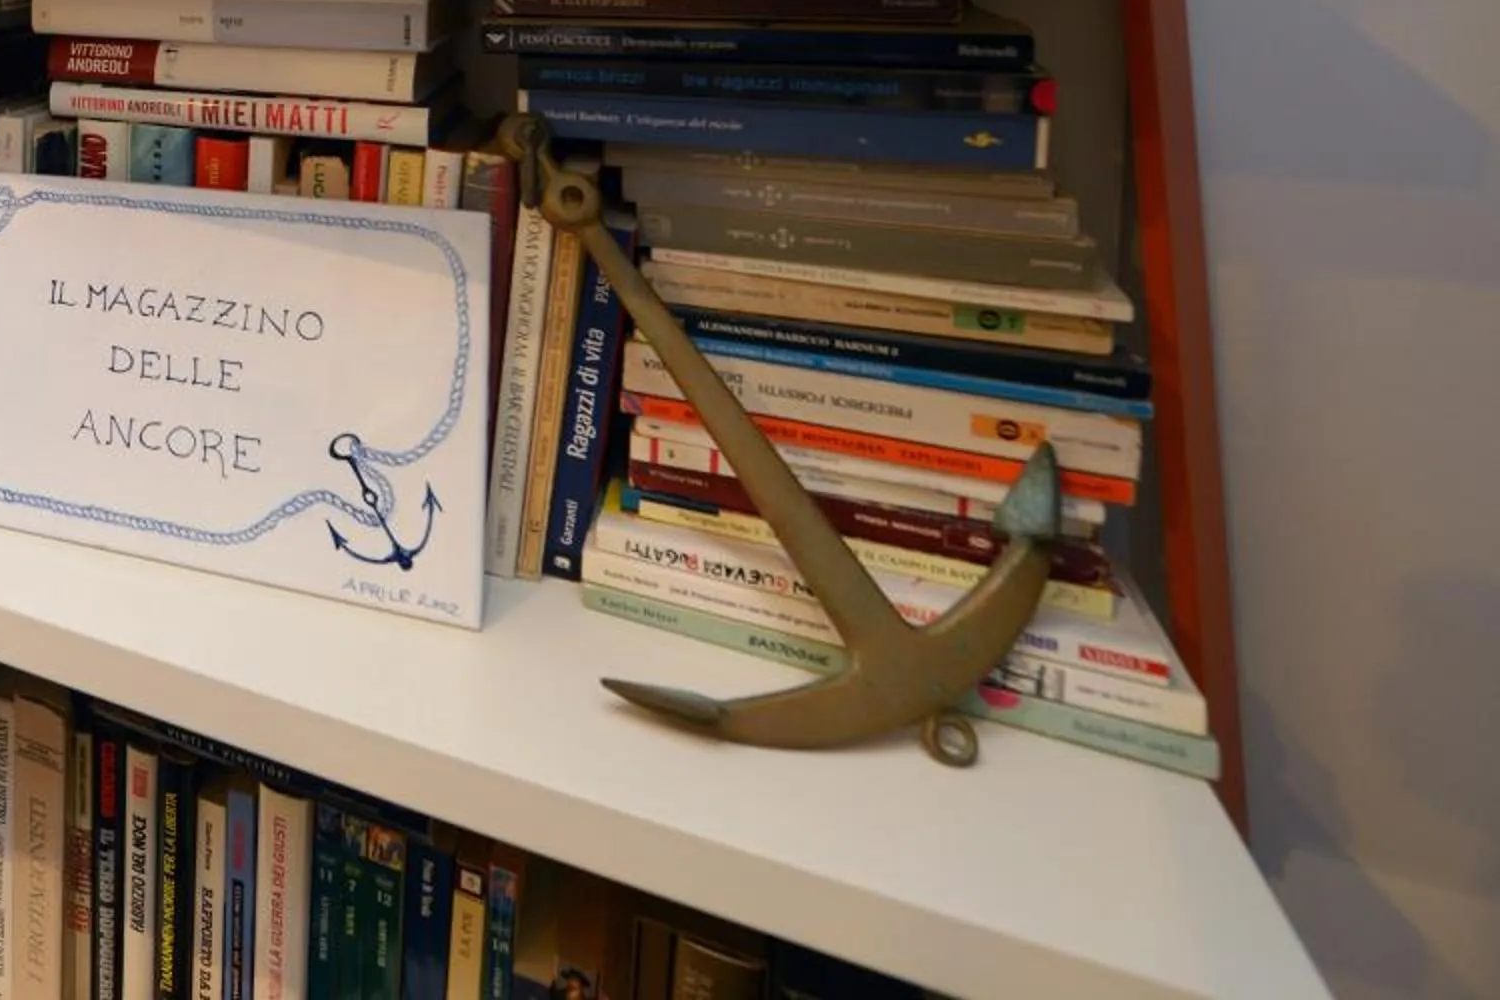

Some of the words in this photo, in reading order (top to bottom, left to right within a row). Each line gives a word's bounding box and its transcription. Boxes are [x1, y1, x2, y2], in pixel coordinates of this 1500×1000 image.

[66, 58, 130, 77] ANDREOLI
[70, 41, 133, 60] VITTORINO
[127, 99, 182, 119] ANDREOLI
[186, 100, 195, 125] I
[200, 98, 257, 129] MIEI
[264, 101, 348, 136] MATTI
[85, 282, 326, 342] MAGAZZINO
[582, 327, 606, 362] vita
[106, 344, 245, 392] DELLE
[576, 362, 599, 385] di
[71, 408, 263, 479] ANCORE
[566, 388, 597, 461] Ragazzi
[560, 499, 579, 546] Garzanti
[340, 576, 413, 605] APRILE
[132, 815, 147, 850] NOCE
[164, 837, 177, 852] LA
[100, 849, 114, 902] TERZO
[131, 851, 146, 874] DEL
[163, 854, 176, 874] PER
[28, 797, 47, 967] PROTAGONISTI
[130, 876, 147, 934] FABRIZIO
[269, 891, 284, 947] GUERRA
